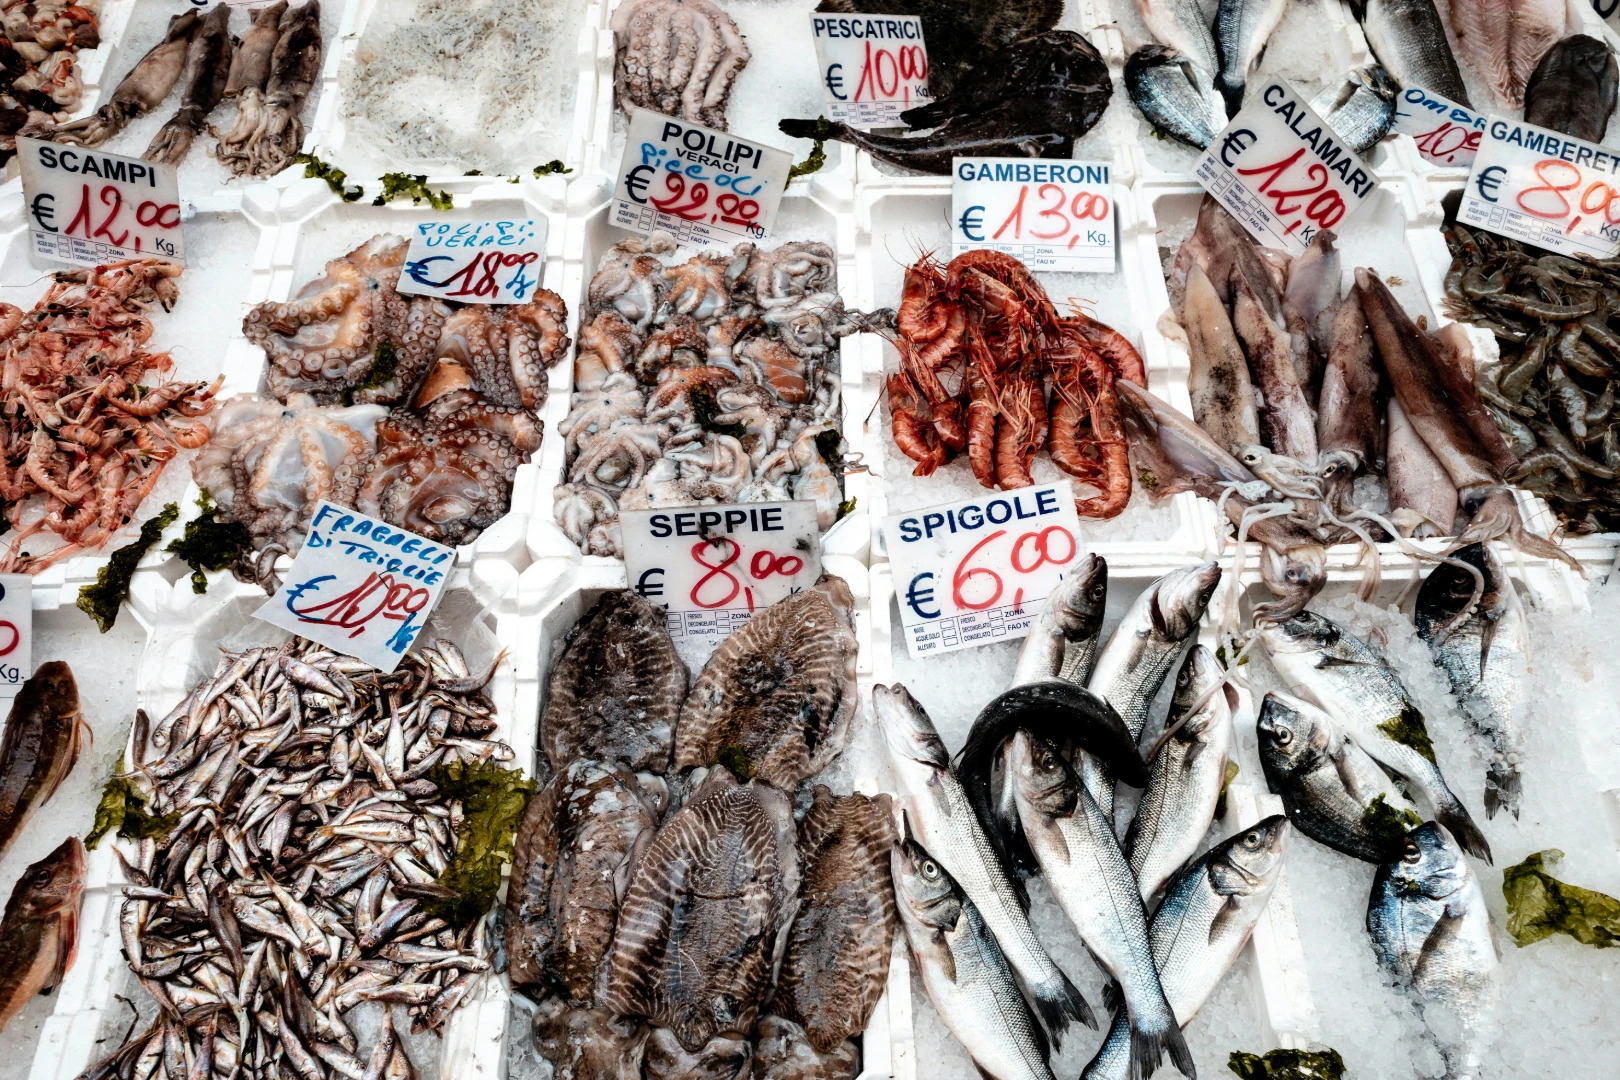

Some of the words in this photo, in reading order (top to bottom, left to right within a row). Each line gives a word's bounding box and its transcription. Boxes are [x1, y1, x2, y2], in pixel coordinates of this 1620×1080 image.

[813, 18, 921, 40] PESCATRICI
[825, 63, 848, 101] €
[661, 121, 763, 169] POLIPI
[1221, 128, 1258, 168] €
[1263, 84, 1375, 199] CALAMARI
[38, 146, 156, 188] SCAMPI
[675, 147, 740, 175] VERACI
[958, 162, 1109, 185] GAMBERONI
[624, 164, 656, 204] €
[1475, 165, 1508, 203] €
[30, 193, 59, 233] €
[958, 205, 986, 242] €
[1256, 208, 1271, 222] ZONA
[690, 236, 702, 244] FAO
[692, 225, 710, 235] ZONA
[1541, 236, 1554, 244] FAO
[1544, 225, 1562, 235] ZONA
[108, 248, 125, 257] ZONA
[649, 507, 785, 538] SEPPIE
[899, 489, 1060, 543] SPIGOLE
[634, 567, 669, 610] €
[905, 571, 941, 619] €
[731, 612, 752, 620] ZONA
[1004, 608, 1025, 618] ZONA
[1007, 622, 1021, 631] FAO
[963, 631, 991, 642] CONGELATO
